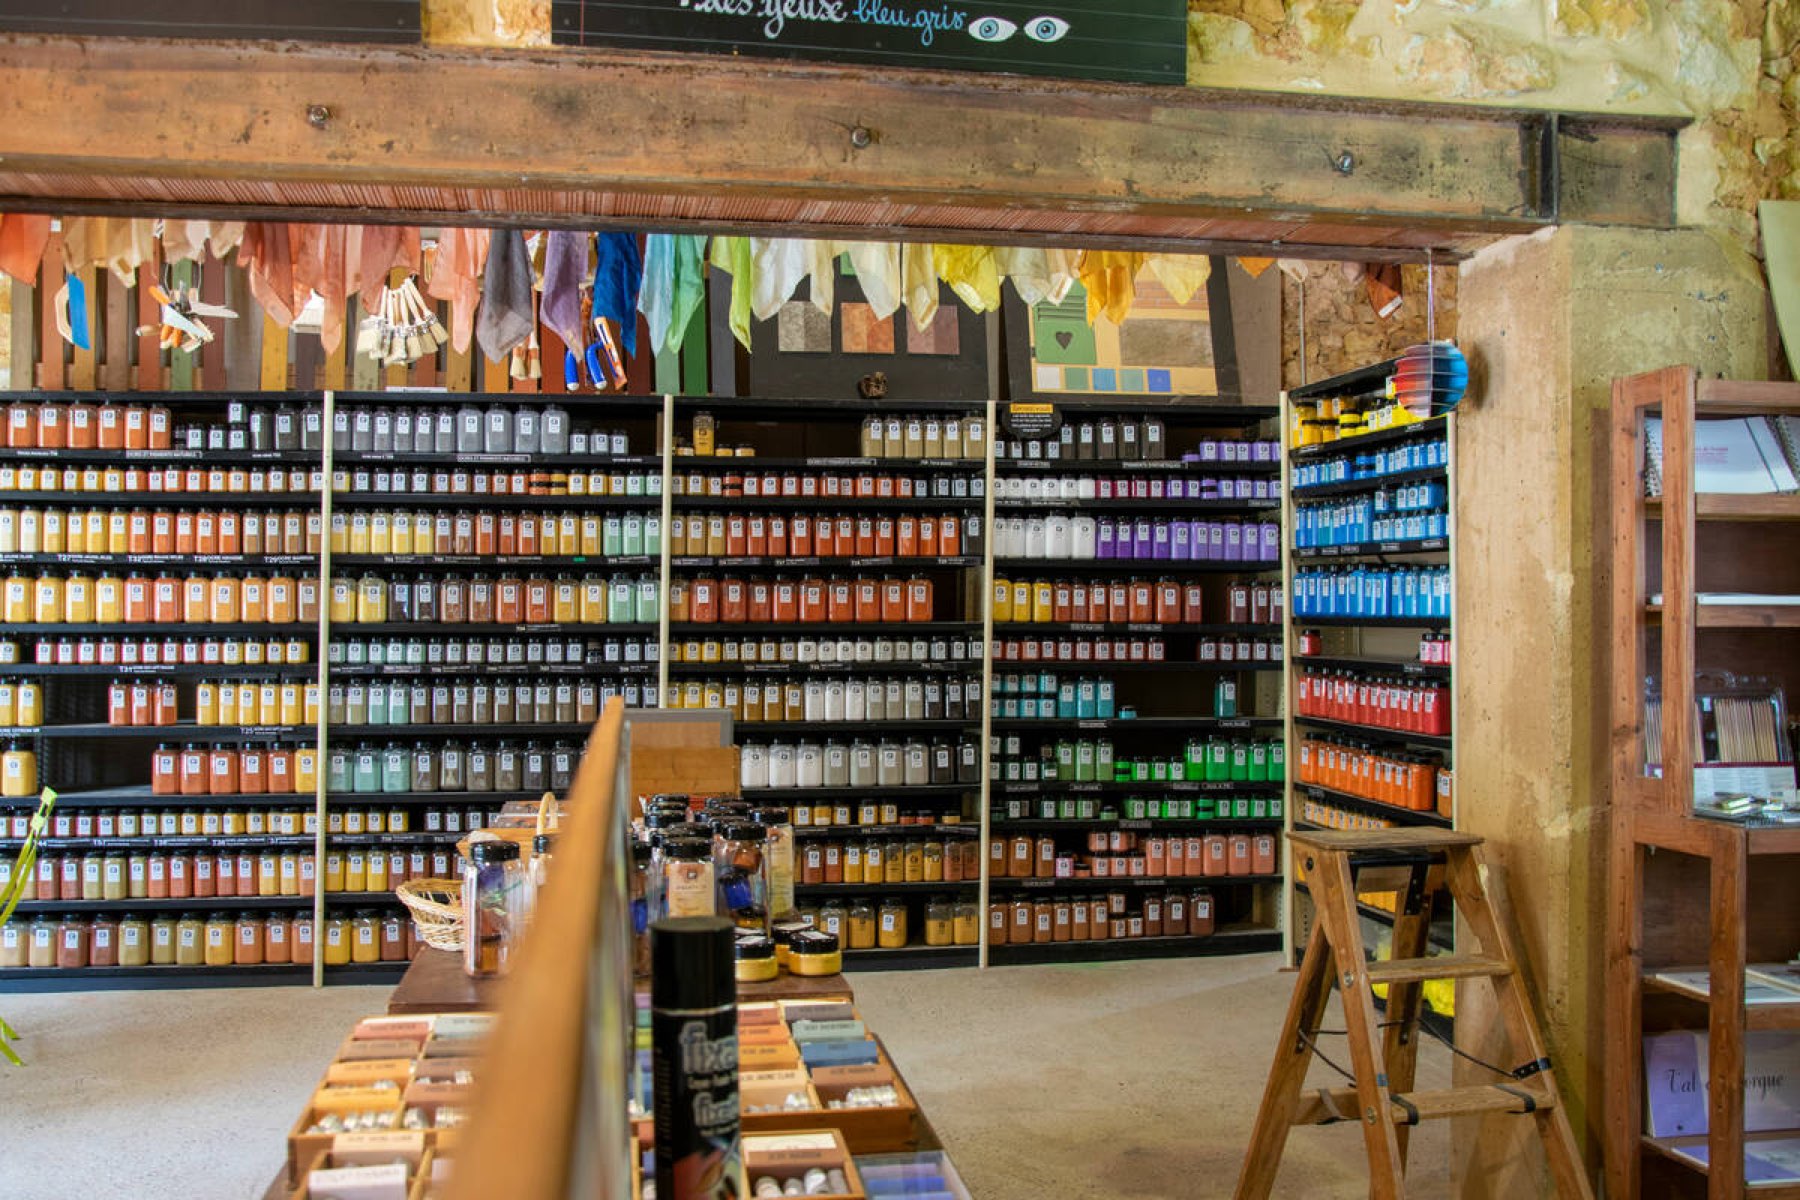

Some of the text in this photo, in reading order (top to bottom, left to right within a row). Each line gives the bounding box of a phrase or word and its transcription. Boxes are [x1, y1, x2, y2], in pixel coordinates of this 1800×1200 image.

[756, 0, 849, 39] yeux
[852, 0, 911, 27] bleu
[911, 6, 967, 46] gris
